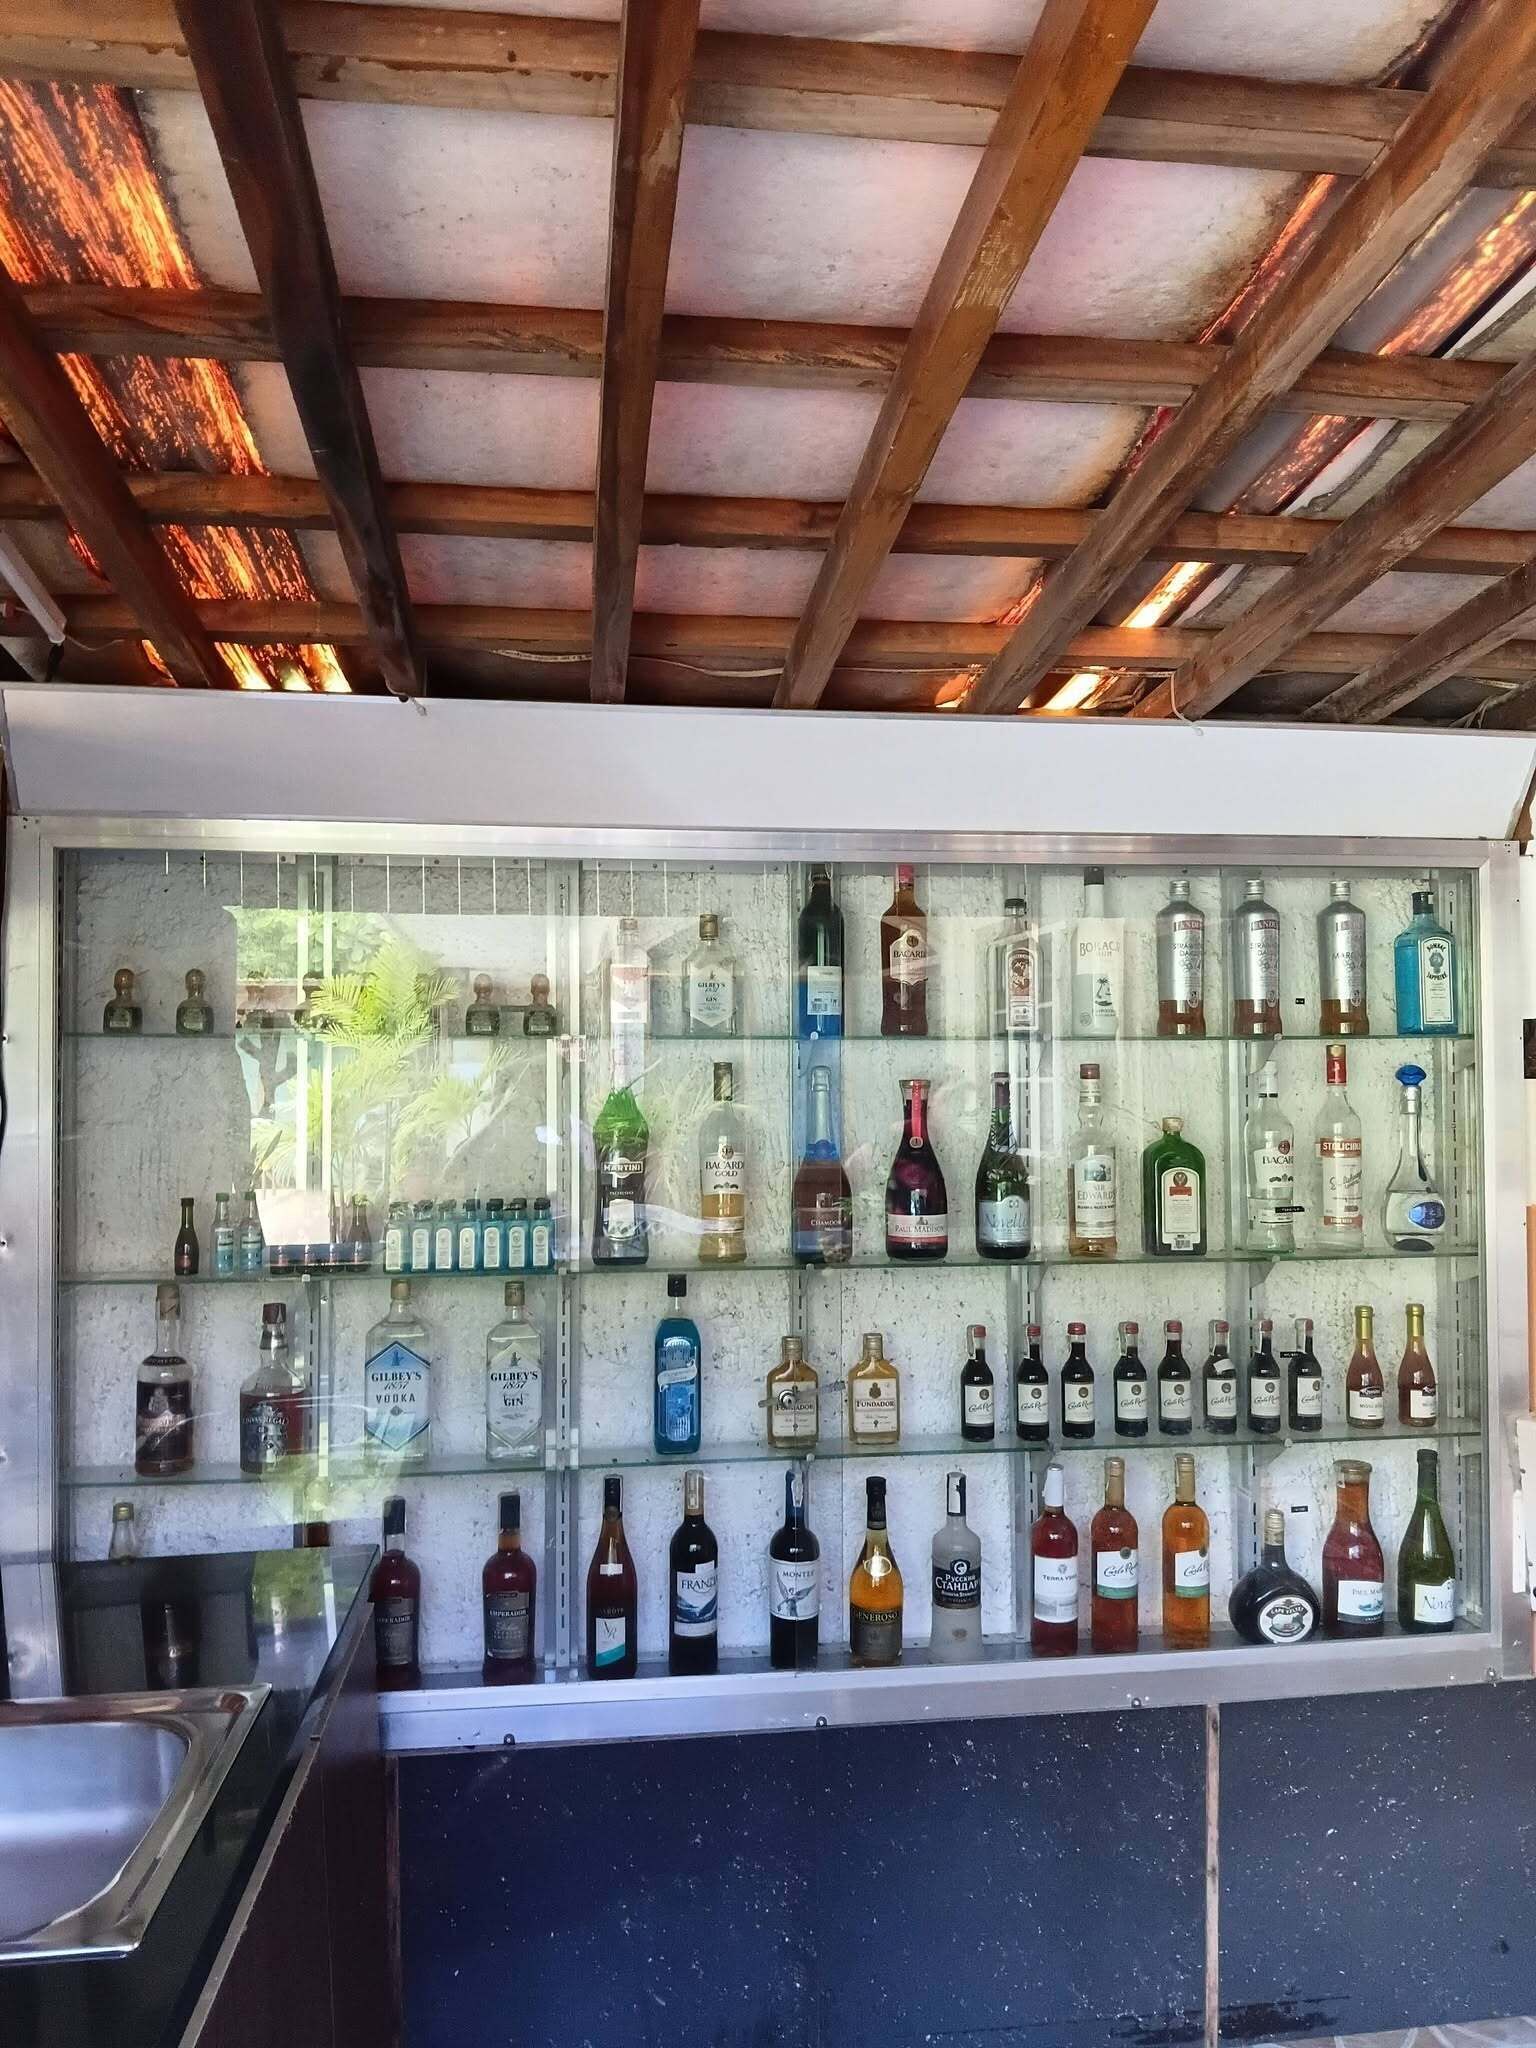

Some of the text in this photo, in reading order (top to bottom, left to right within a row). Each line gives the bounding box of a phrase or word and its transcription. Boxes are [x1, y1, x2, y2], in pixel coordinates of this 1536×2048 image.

[893, 950, 927, 959] BACARD
[705, 1161, 745, 1170] BACARD
[1263, 1156, 1294, 1165] BACAR
[603, 1163, 641, 1172] MARTINI
[371, 1371, 422, 1382] GILBEY'S
[490, 1371, 538, 1382] GILBEY'S
[376, 1393, 416, 1404] VODKA
[504, 1396, 524, 1407] GIN
[935, 1576, 979, 1591] СТАНДАР
